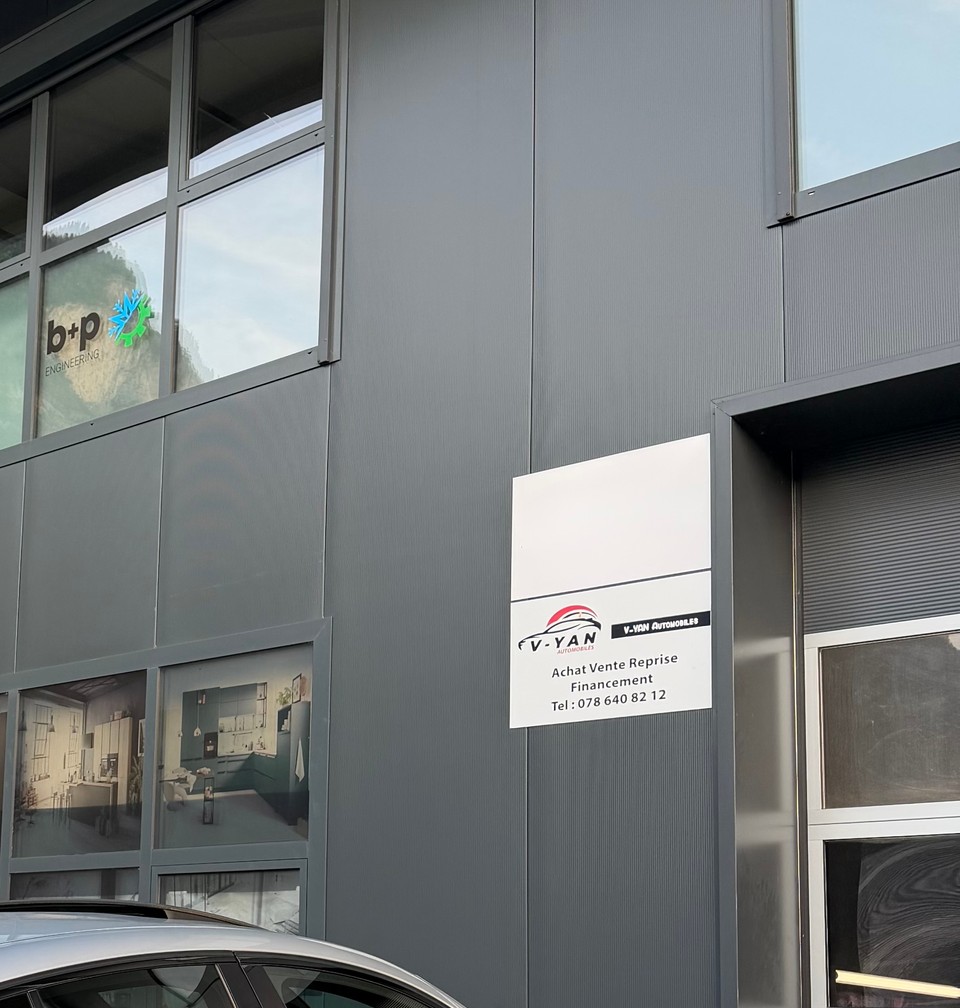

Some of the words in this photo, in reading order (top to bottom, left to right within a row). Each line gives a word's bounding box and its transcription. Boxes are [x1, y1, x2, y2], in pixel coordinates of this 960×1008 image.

[46, 312, 101, 355] b+p
[45, 348, 100, 377] ENGINEERING
[624, 623, 650, 635] V-YAN
[530, 631, 597, 652] V-YAN
[556, 645, 595, 655] AUTOMOBILES
[551, 663, 587, 679] Achat
[589, 659, 626, 674] Vente
[629, 653, 679, 669] Reprise
[570, 673, 654, 693] Financement
[577, 697, 602, 709] 078
[604, 693, 628, 706] 640
[631, 691, 647, 703] 82
[651, 689, 667, 701] 12
